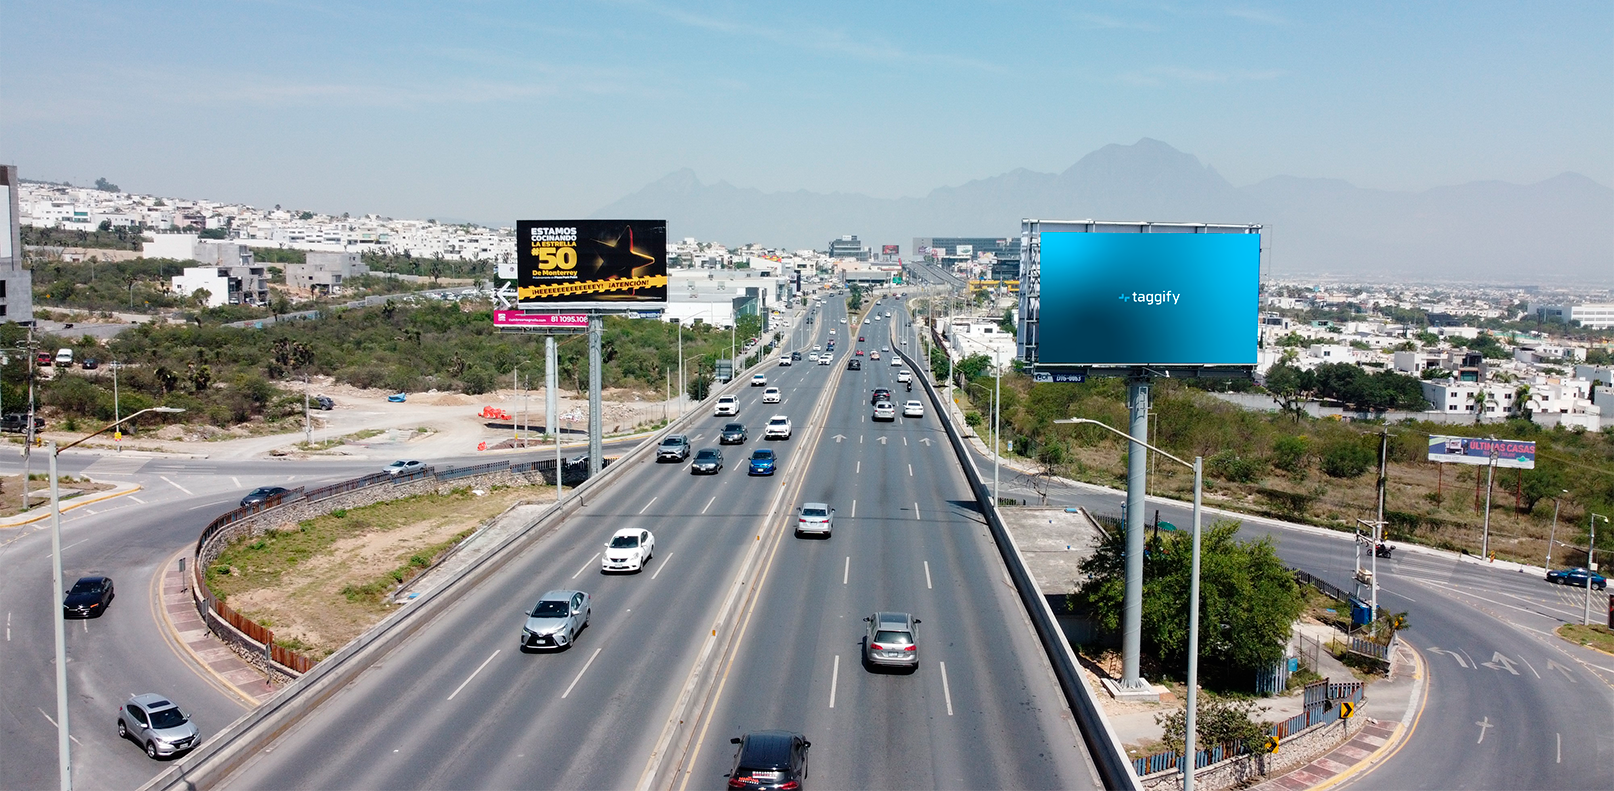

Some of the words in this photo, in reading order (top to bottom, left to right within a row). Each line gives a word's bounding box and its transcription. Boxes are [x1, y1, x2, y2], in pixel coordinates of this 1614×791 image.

[531, 227, 577, 235] ESTAMOS
[1132, 290, 1180, 305] taggify
[551, 315, 558, 323] 81
[1506, 444, 1536, 454] CASAS
